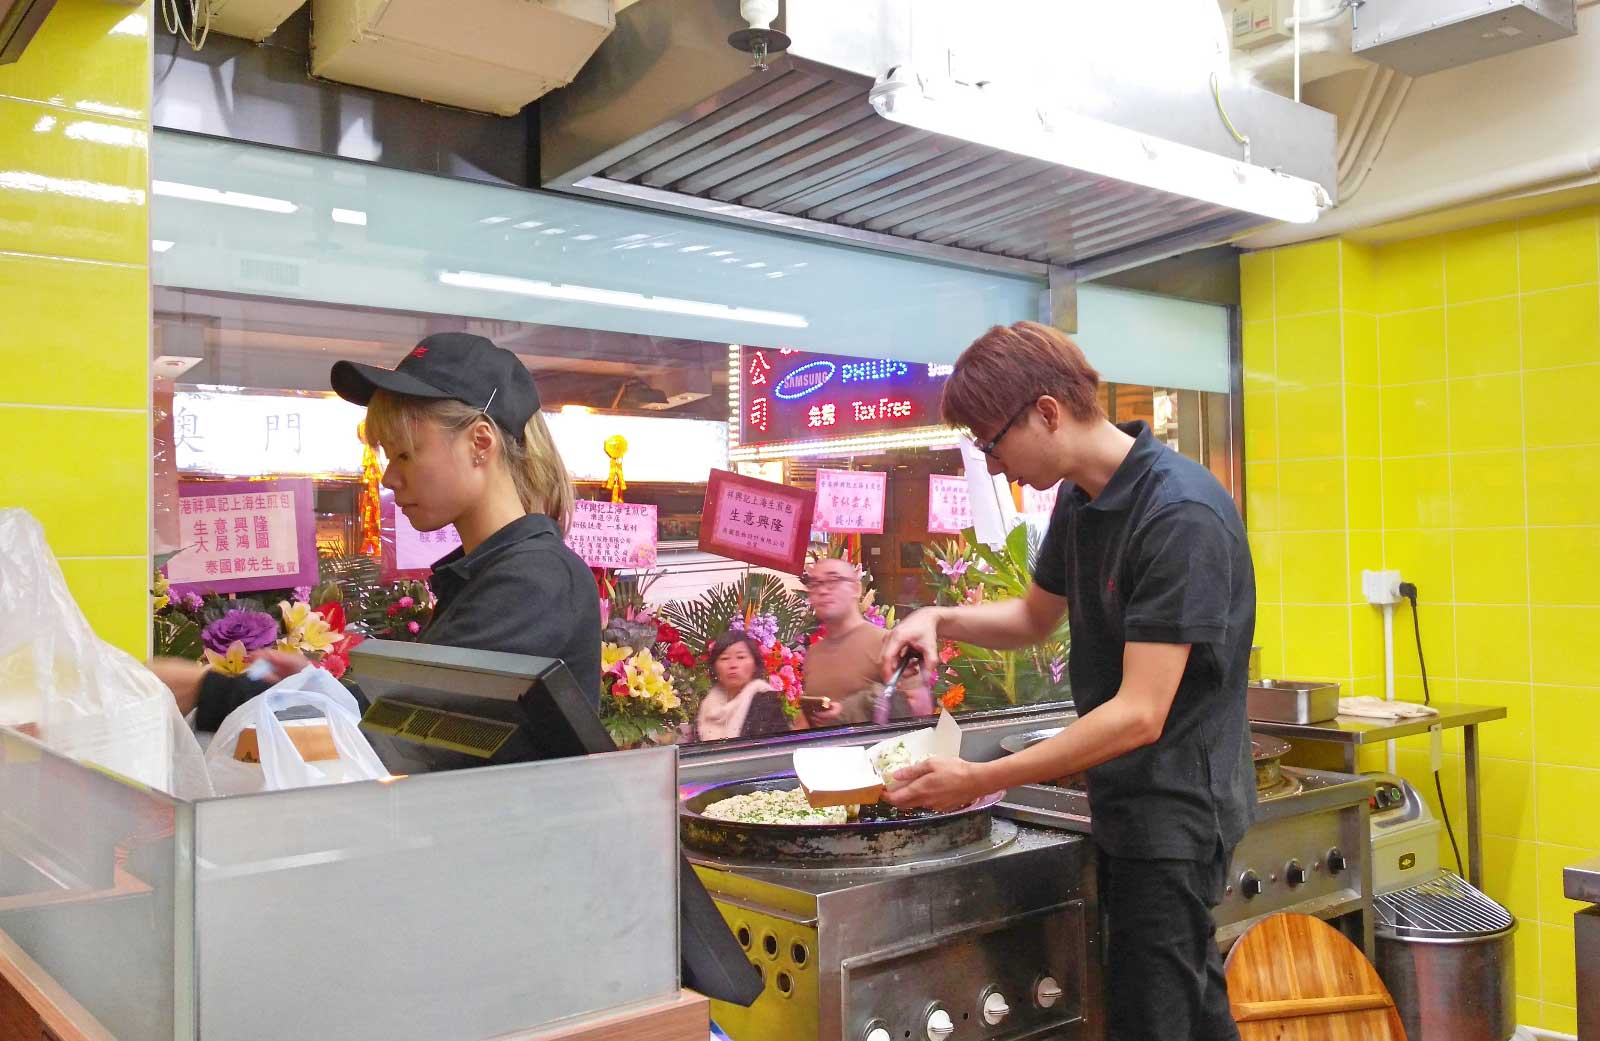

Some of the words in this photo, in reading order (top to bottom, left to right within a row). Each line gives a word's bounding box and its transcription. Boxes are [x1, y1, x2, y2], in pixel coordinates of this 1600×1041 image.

[783, 371, 829, 389] SAMSUNG
[842, 358, 908, 383] PHILIPS
[749, 351, 771, 431] 公司
[852, 401, 876, 421] Tax
[879, 398, 912, 419] Free
[193, 515, 269, 536] 生意興隆
[729, 507, 785, 533] 生意興隆
[194, 532, 270, 554] 大展鴻圖
